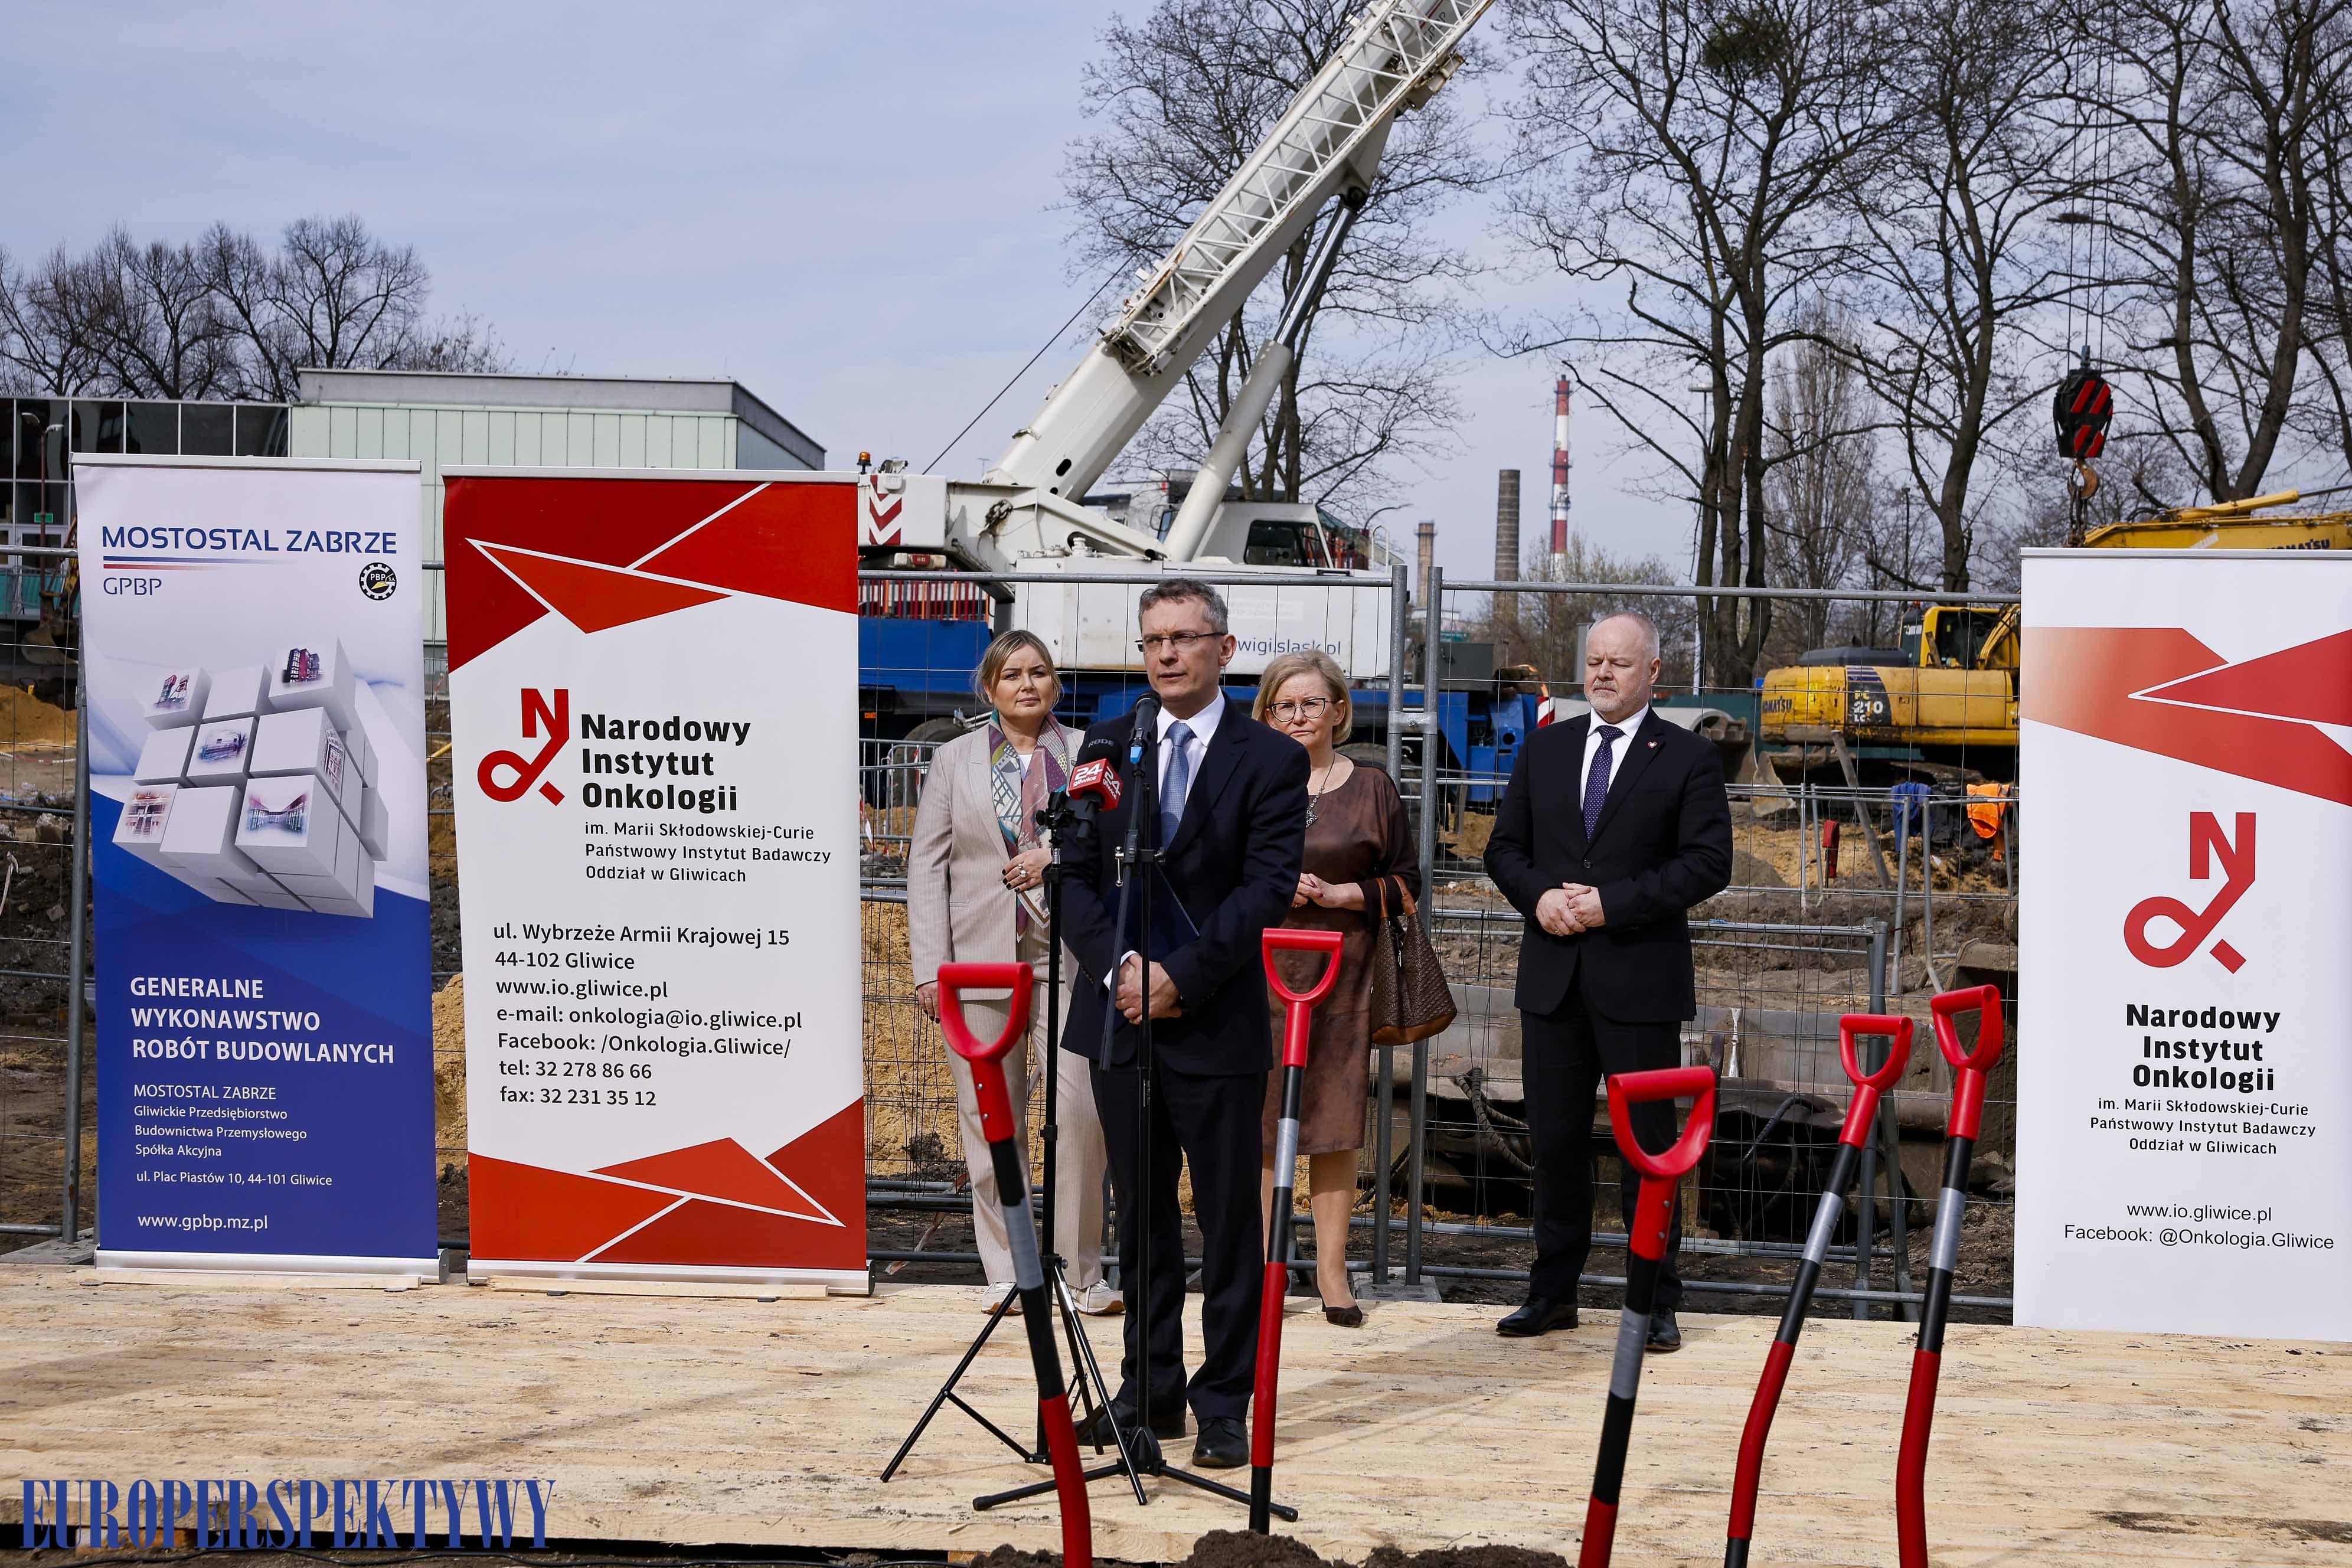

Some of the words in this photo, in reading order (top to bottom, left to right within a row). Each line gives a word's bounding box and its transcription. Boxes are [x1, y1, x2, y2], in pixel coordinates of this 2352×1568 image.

[102, 526, 279, 551] MOSTOSTAL
[286, 530, 397, 554] ZABRZE
[2266, 538, 2330, 549] ATSU
[103, 577, 162, 596] GPBP
[1237, 638, 1341, 655] wigi.slask.pl
[1853, 700, 1884, 714] 210
[581, 714, 751, 746] Narodowy
[582, 748, 714, 779] Instytut
[1074, 763, 1103, 781] 24
[1073, 775, 1097, 788] gliwice
[1104, 766, 1121, 796] 24
[583, 782, 737, 814] Onkologii
[585, 821, 608, 835] im.
[614, 822, 654, 836] Marii
[659, 823, 814, 840] Skłodowskiej-Curie
[586, 843, 677, 860] Państwowy
[683, 845, 746, 861] Instytut
[752, 847, 831, 864] Badawczy
[586, 865, 646, 880] Oddział
[651, 870, 664, 880] w
[669, 867, 746, 882] Gliwicach
[494, 922, 517, 939] ul.
[522, 923, 615, 944] Wybrzeże
[619, 926, 671, 943] Armii
[677, 927, 761, 949] Krajowej
[768, 930, 789, 945] 15
[495, 951, 560, 968] 44-102
[565, 952, 635, 969] Gliwice
[130, 977, 263, 999] GENERALNE
[496, 978, 668, 1001] www.io.gliwice.pl
[130, 1008, 320, 1031] WYKONAWSTWO
[496, 1005, 563, 1023] e-mail:
[569, 1007, 802, 1032] onkologia@io.gliwice.pl
[2126, 1004, 2281, 1033] Narodowy
[133, 1036, 210, 1059] ROBÓT
[217, 1041, 394, 1063] BUDOWLANYCH
[498, 1033, 595, 1050] Facebook:
[600, 1034, 791, 1059] /Onkologia.Gliwice/
[2144, 1035, 2263, 1063] Instytut
[499, 1059, 530, 1076] tel:
[535, 1061, 558, 1076] 32
[563, 1061, 597, 1077] 278
[602, 1063, 624, 1078] 86
[629, 1063, 652, 1079] 66
[2133, 1064, 2273, 1094] Onkologii
[134, 1084, 220, 1099] MOSTOSTAL
[223, 1086, 276, 1100] ZABRZE
[499, 1086, 534, 1103] fax:
[540, 1088, 562, 1103] 32
[567, 1089, 601, 1105] 231
[606, 1090, 629, 1106] 35
[635, 1091, 656, 1106] 12
[134, 1105, 186, 1117] Gliwickie
[189, 1106, 288, 1121] Przedsiębiorstwo
[2099, 1097, 2119, 1110] im.
[2125, 1098, 2161, 1111] Marii
[2166, 1100, 2308, 1116] Skłodowskiej-Curie
[135, 1125, 213, 1137] Budownictwa
[217, 1126, 307, 1142] Przemysłowego
[2090, 1117, 2174, 1133] Państwowy
[2180, 1120, 2237, 1134] Instytut
[2243, 1122, 2316, 1138] Badawczy
[135, 1144, 174, 1157] Spółka
[177, 1145, 221, 1159] Akcyjna
[2129, 1138, 2184, 1151] Oddział
[2189, 1142, 2201, 1152] w
[2206, 1141, 2276, 1154] Gliwicach
[136, 1171, 151, 1181] ul.
[153, 1171, 177, 1182] Plac
[180, 1172, 225, 1183] Piastów
[228, 1173, 245, 1185] 10,
[247, 1174, 286, 1184] 44-101
[290, 1174, 332, 1185] Gliwice
[138, 1213, 267, 1232] www.gpbp.mz.pl
[2126, 1203, 2271, 1224] www.io.gliwice.pl
[2065, 1224, 2152, 1242] Facebook:
[2159, 1228, 2334, 1249] @Onkologia.Gliwice
